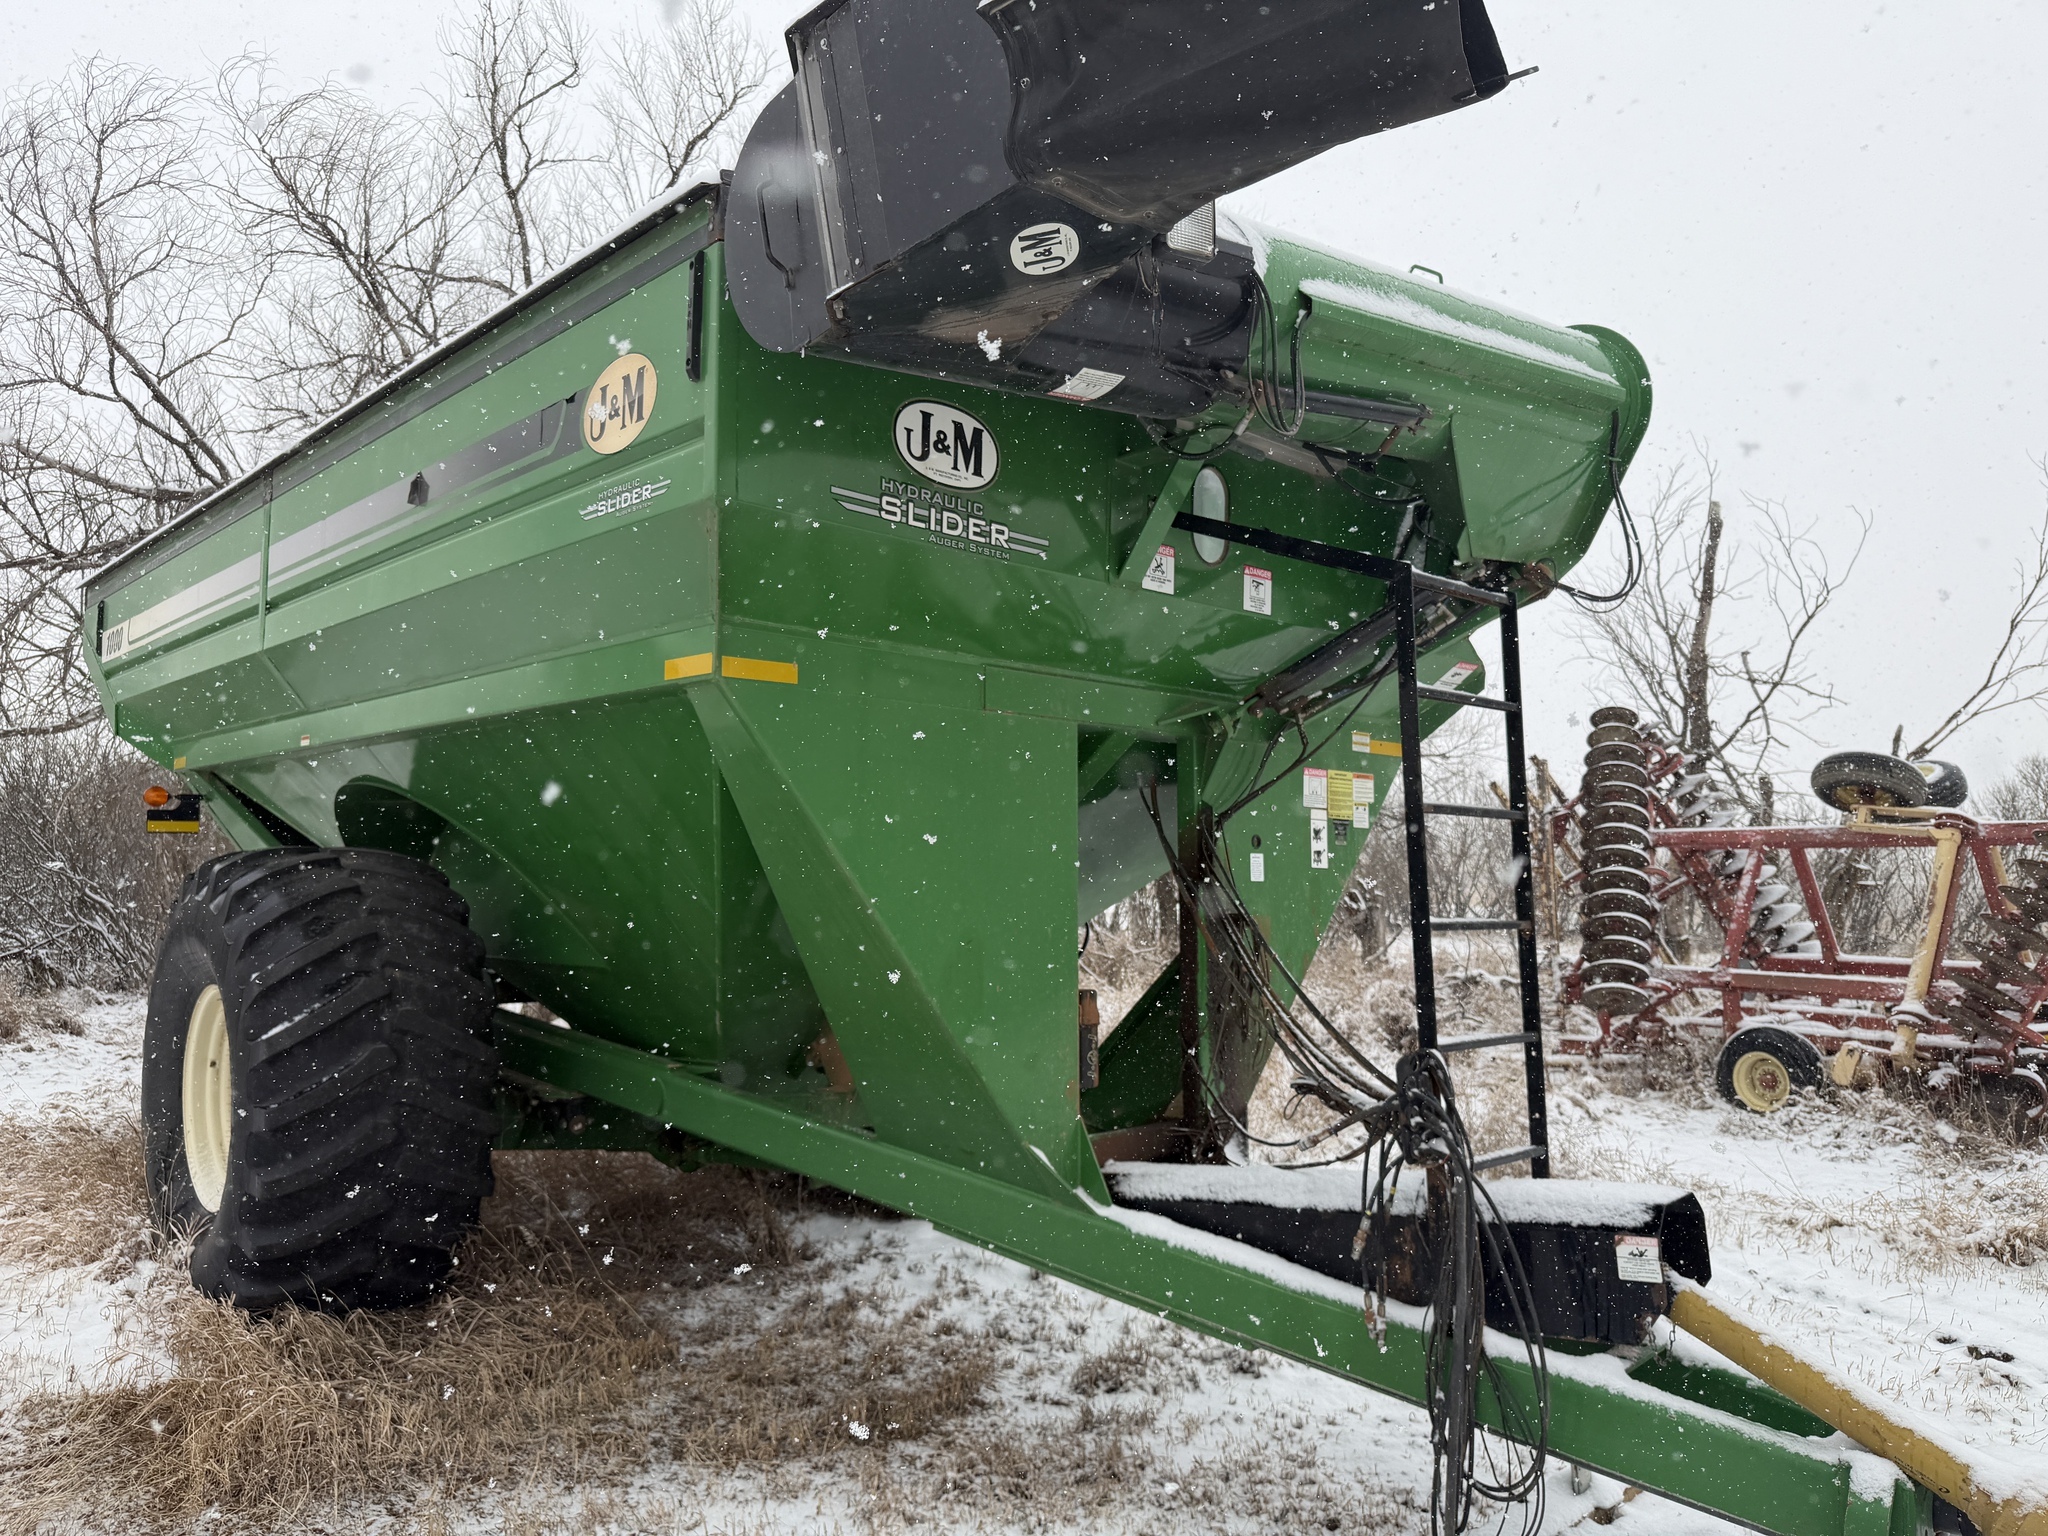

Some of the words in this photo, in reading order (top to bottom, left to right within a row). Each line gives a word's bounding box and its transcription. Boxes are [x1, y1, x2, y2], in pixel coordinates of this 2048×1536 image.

[1018, 227, 1065, 271] J&M
[588, 365, 646, 442] J&M
[904, 410, 985, 479] J&M
[597, 484, 652, 516] SLIDER
[598, 478, 640, 499] HYDRAULIC
[881, 478, 984, 516] HYDRAULIC
[880, 496, 1010, 549] SLIDER
[929, 534, 965, 550] AUGER
[969, 543, 1010, 560] SYSTEM
[1157, 546, 1175, 557] NGER
[1249, 566, 1272, 580] DANGER
[106, 626, 123, 656] 1000
